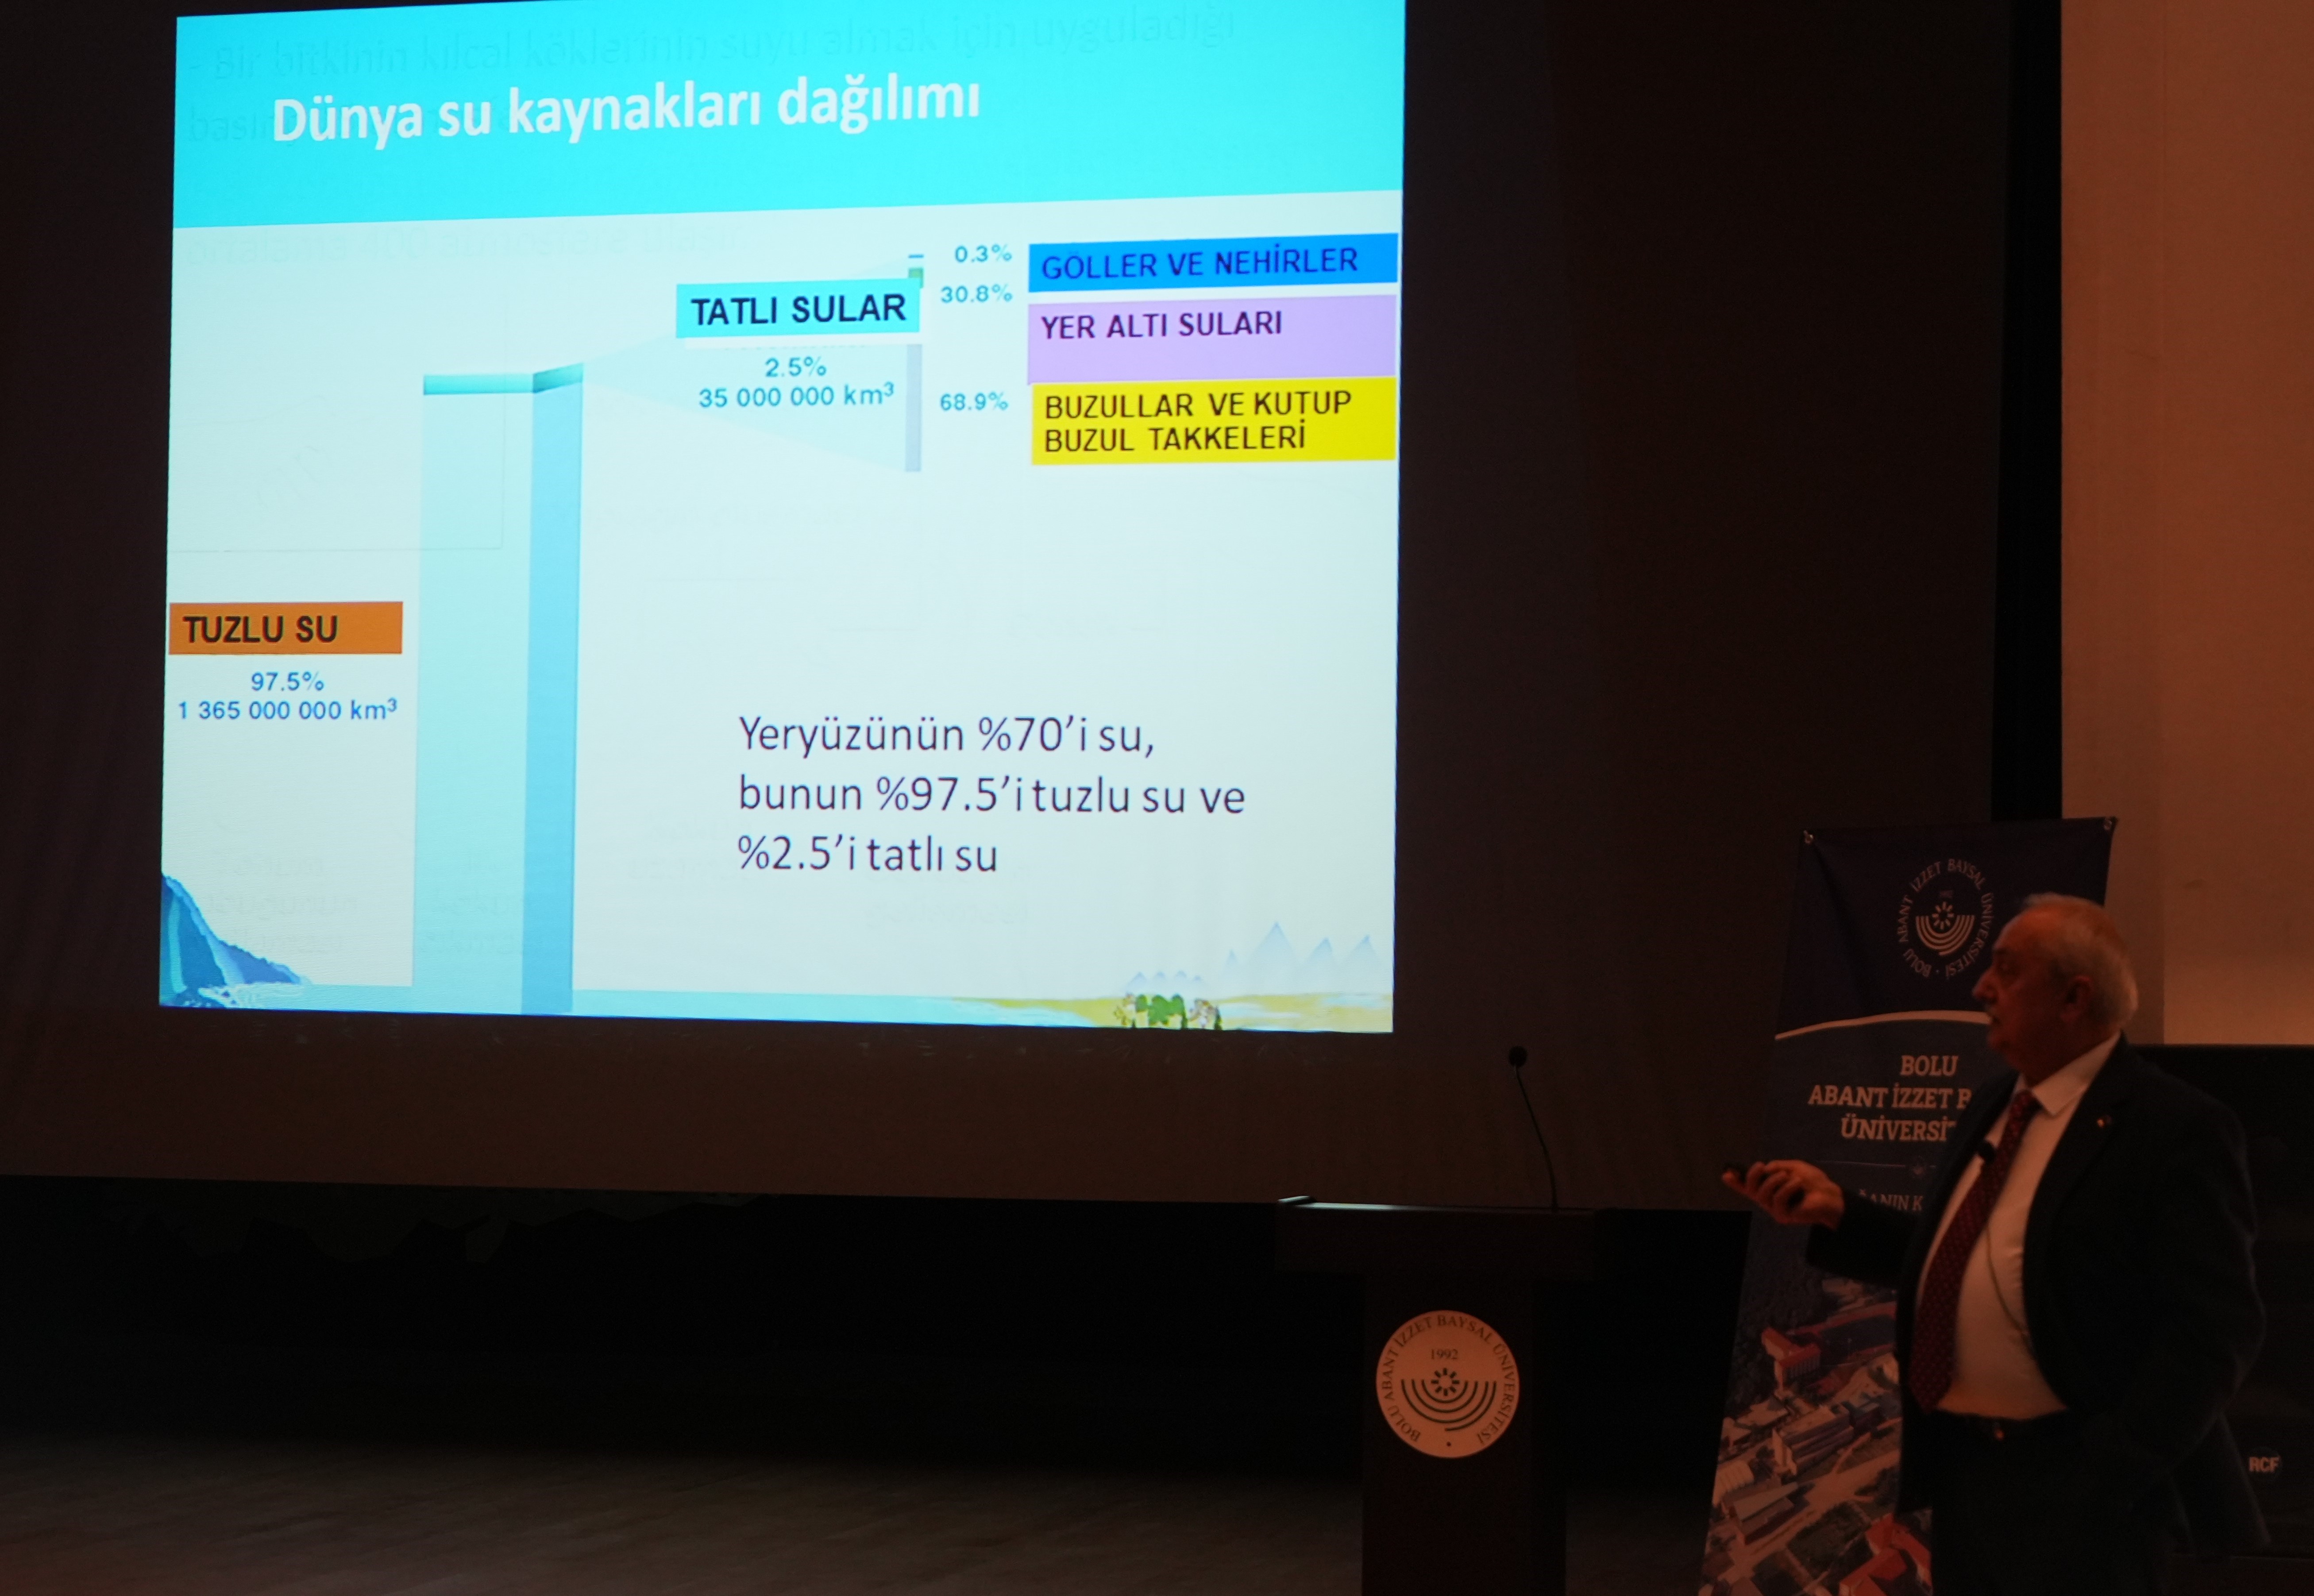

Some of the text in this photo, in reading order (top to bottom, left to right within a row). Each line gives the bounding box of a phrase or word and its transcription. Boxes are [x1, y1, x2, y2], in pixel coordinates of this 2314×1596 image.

[274, 72, 980, 150] Dünya su kaynakları dağılımı
[954, 244, 1013, 263] 0.3%
[1042, 244, 1358, 279] GÖLLER VE NEHİRLER
[941, 284, 1013, 304] 30.8%
[691, 293, 906, 325] TATLI SULAR
[1041, 311, 1281, 339] YER ALTI SULARI
[765, 356, 827, 378] 2.5%
[699, 387, 728, 408] 35
[737, 386, 782, 408] 000
[790, 386, 835, 406] 000
[940, 391, 1009, 412] 68.9%
[1045, 390, 1351, 419] BUZULLAR VE KUTUP
[1045, 419, 1305, 452] BUZUL TAKKELERİ
[182, 615, 337, 644] TUZLU SU
[251, 671, 325, 691] 97.5%
[179, 701, 187, 719] 1
[199, 700, 241, 720] 365
[249, 700, 291, 720] 000
[299, 700, 342, 720] 000
[739, 716, 964, 759] Yeryüzünün
[1099, 725, 1153, 758] su,
[740, 773, 862, 810] bunun
[1032, 775, 1130, 813] tuzlu
[1143, 786, 1185, 813] su
[1200, 787, 1245, 813] ve
[867, 834, 943, 871] tatlı
[956, 845, 997, 871] su
[1948, 859, 1986, 891] BAYSAL
[1897, 894, 1914, 944] ABANT
[1903, 948, 1932, 978] BOLU
[1900, 1055, 1959, 1076] BOLU
[1808, 1084, 1889, 1108] ABANT
[1892, 1083, 1954, 1109] İZZET
[1841, 1113, 1956, 1141] ÜNİVERSİ
[1438, 1315, 1492, 1344] BAYSAL
[1431, 1349, 1458, 1360] 1992
[1381, 1349, 1399, 1401] ABANT
[1388, 1405, 1421, 1442] BOLU
[2248, 1457, 2280, 1473] RCF
